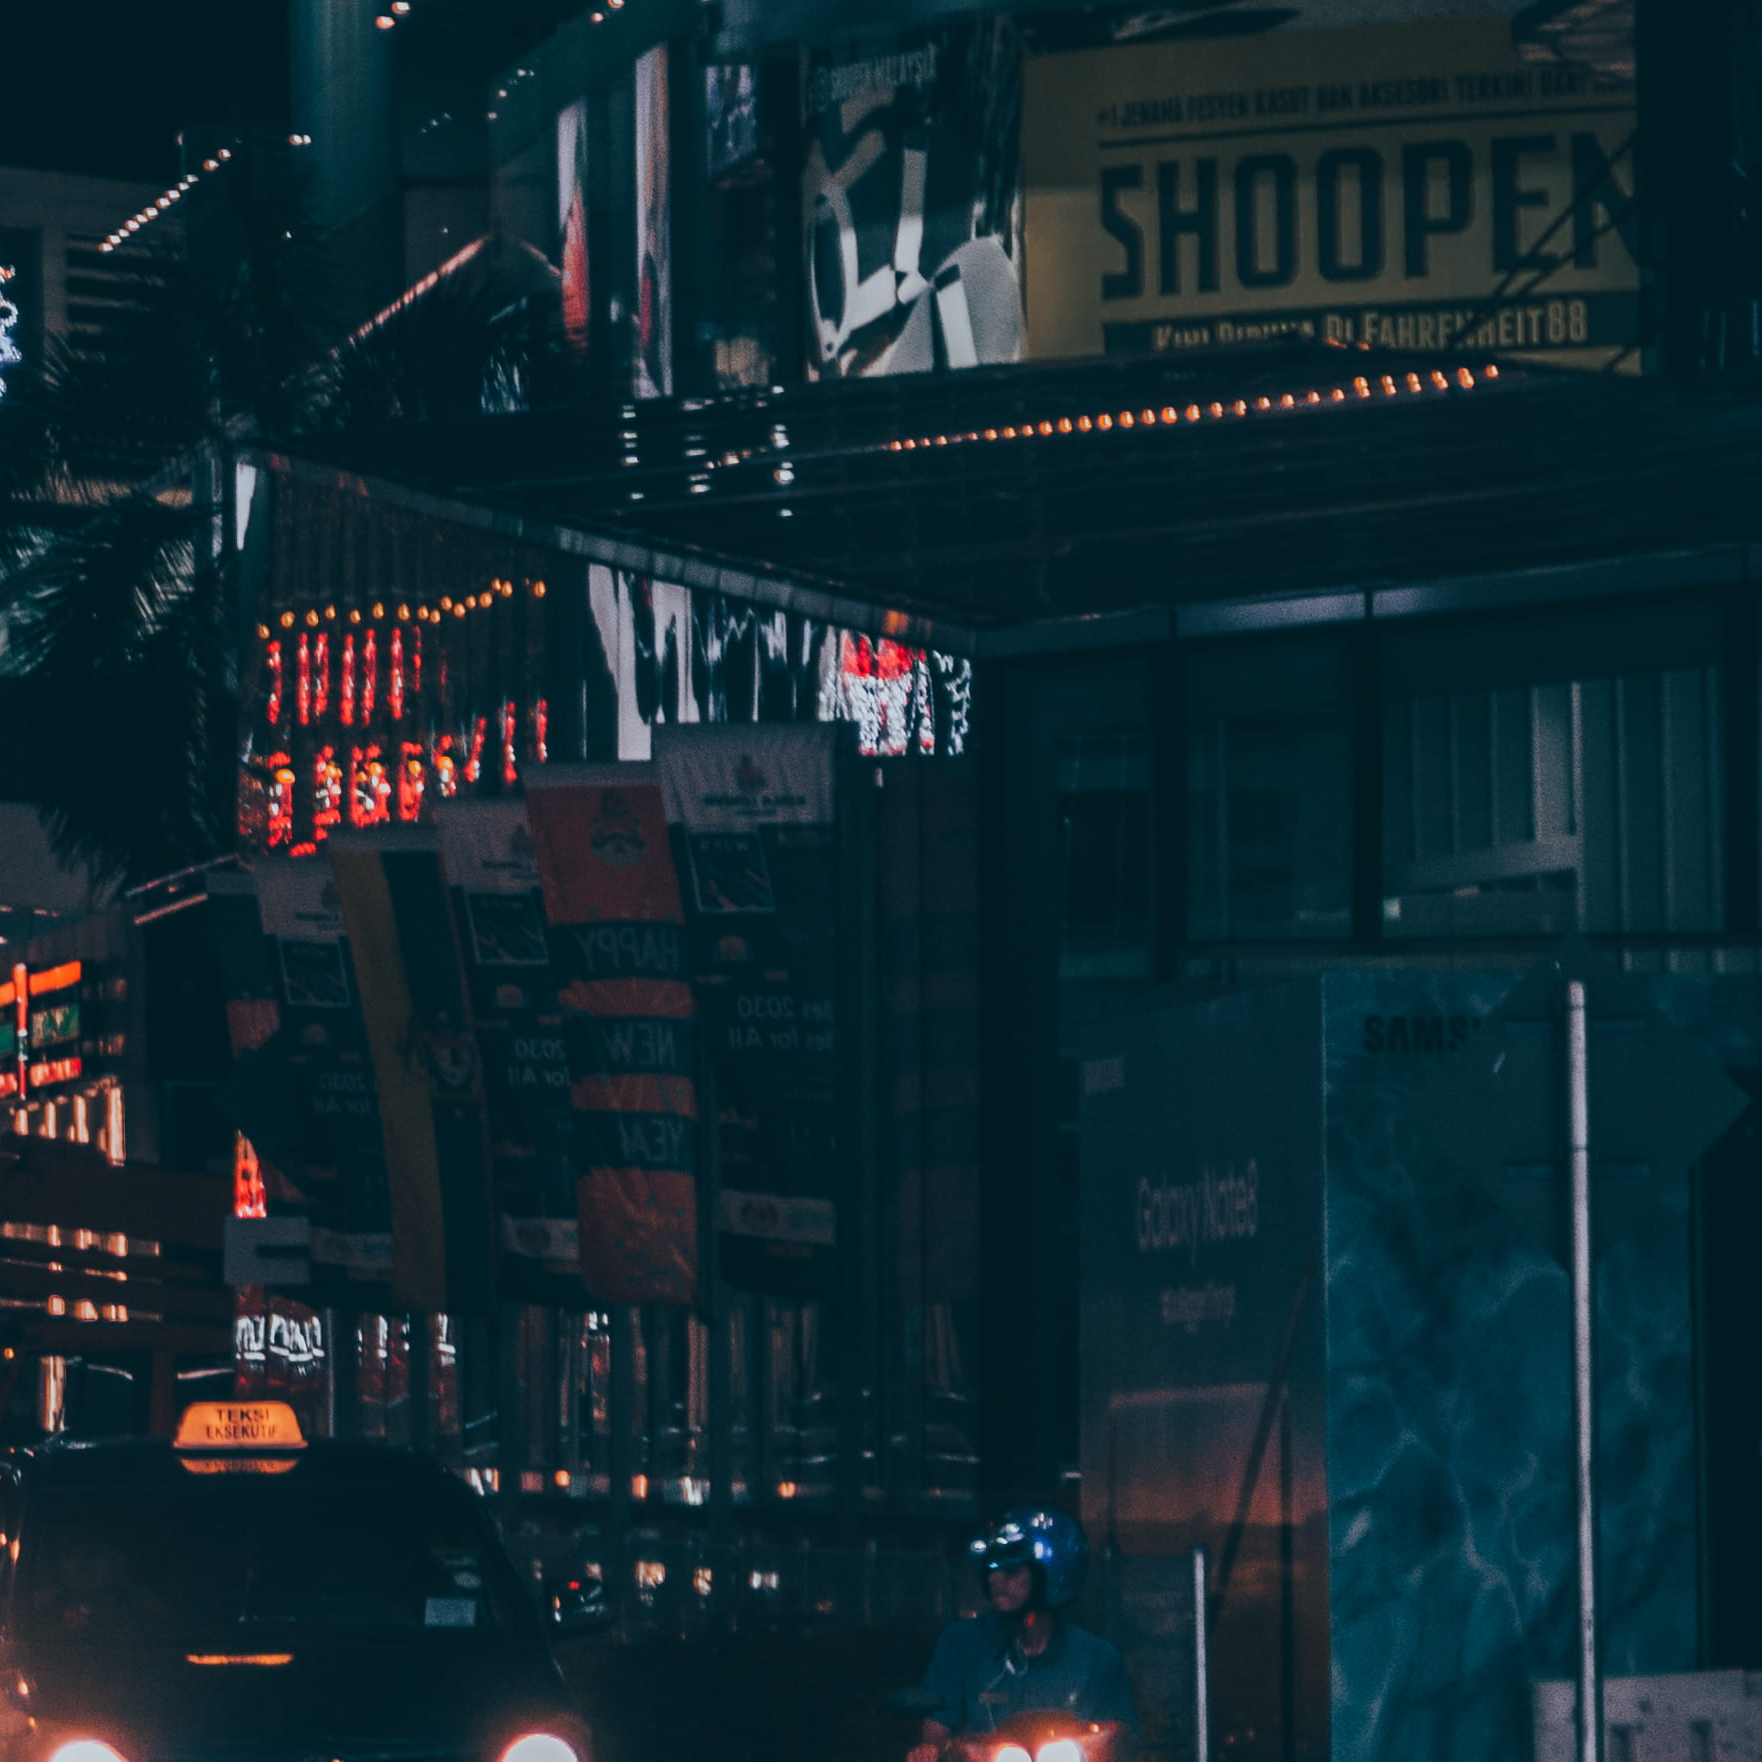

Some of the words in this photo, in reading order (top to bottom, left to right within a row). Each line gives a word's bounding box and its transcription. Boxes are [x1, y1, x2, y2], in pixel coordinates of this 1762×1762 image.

[1454, 70, 1533, 102] TERKINI
[1101, 132, 1640, 300] SHOOPEN
[1196, 1157, 1260, 1242] Note8
[217, 1408, 270, 1422] TEKSI
[206, 1425, 276, 1439] EKSEKUTIF
